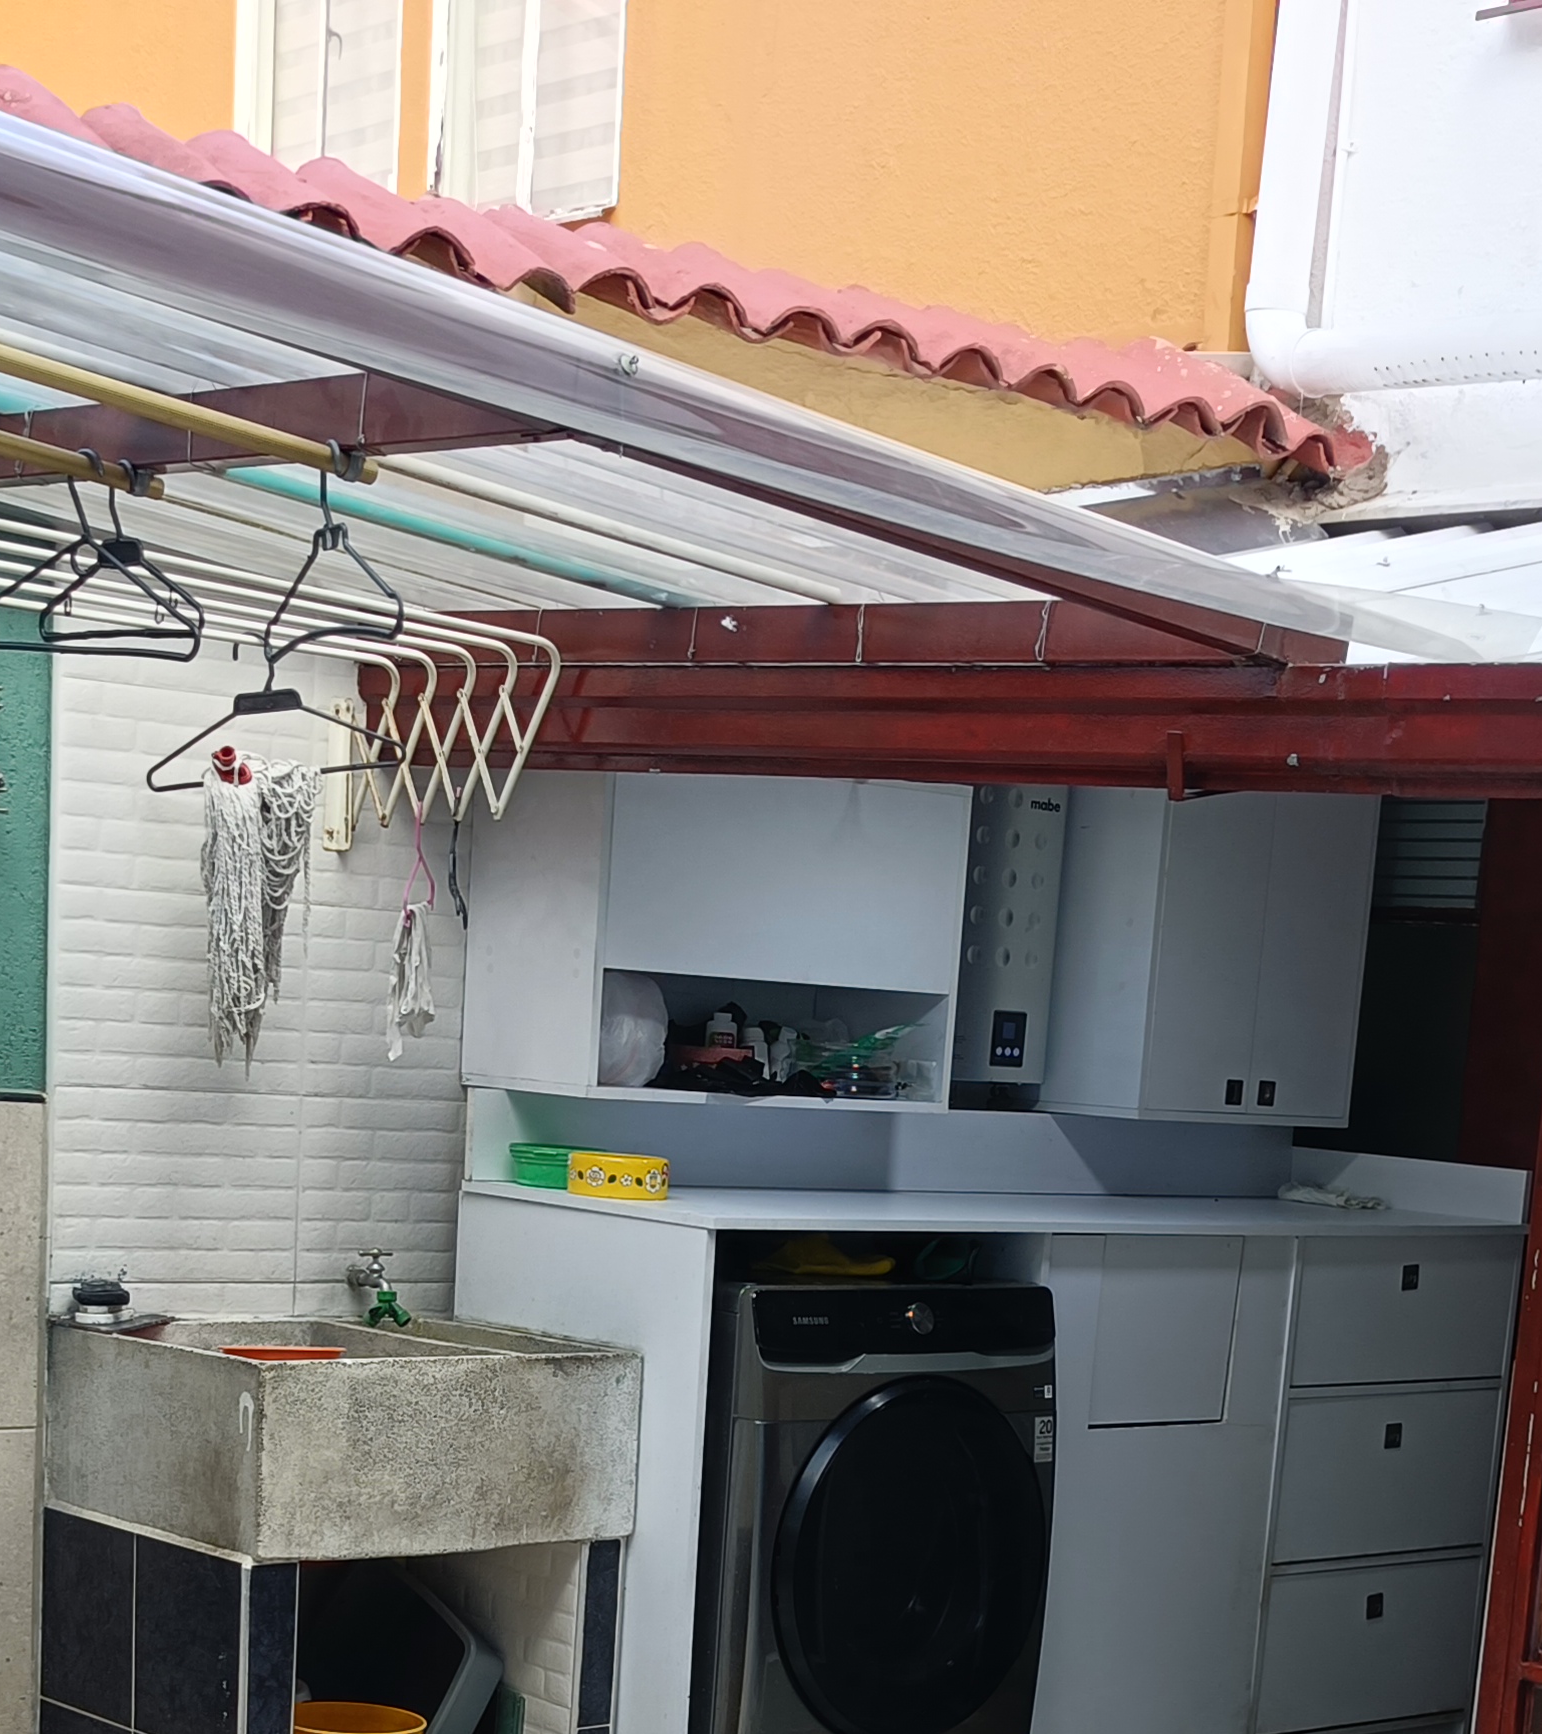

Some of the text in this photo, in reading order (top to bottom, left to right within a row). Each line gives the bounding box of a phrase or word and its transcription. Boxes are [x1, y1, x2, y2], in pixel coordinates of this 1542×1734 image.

[1031, 797, 1061, 813] mabe
[792, 1316, 829, 1325] SAMSUNG
[1039, 1419, 1053, 1435] 20
